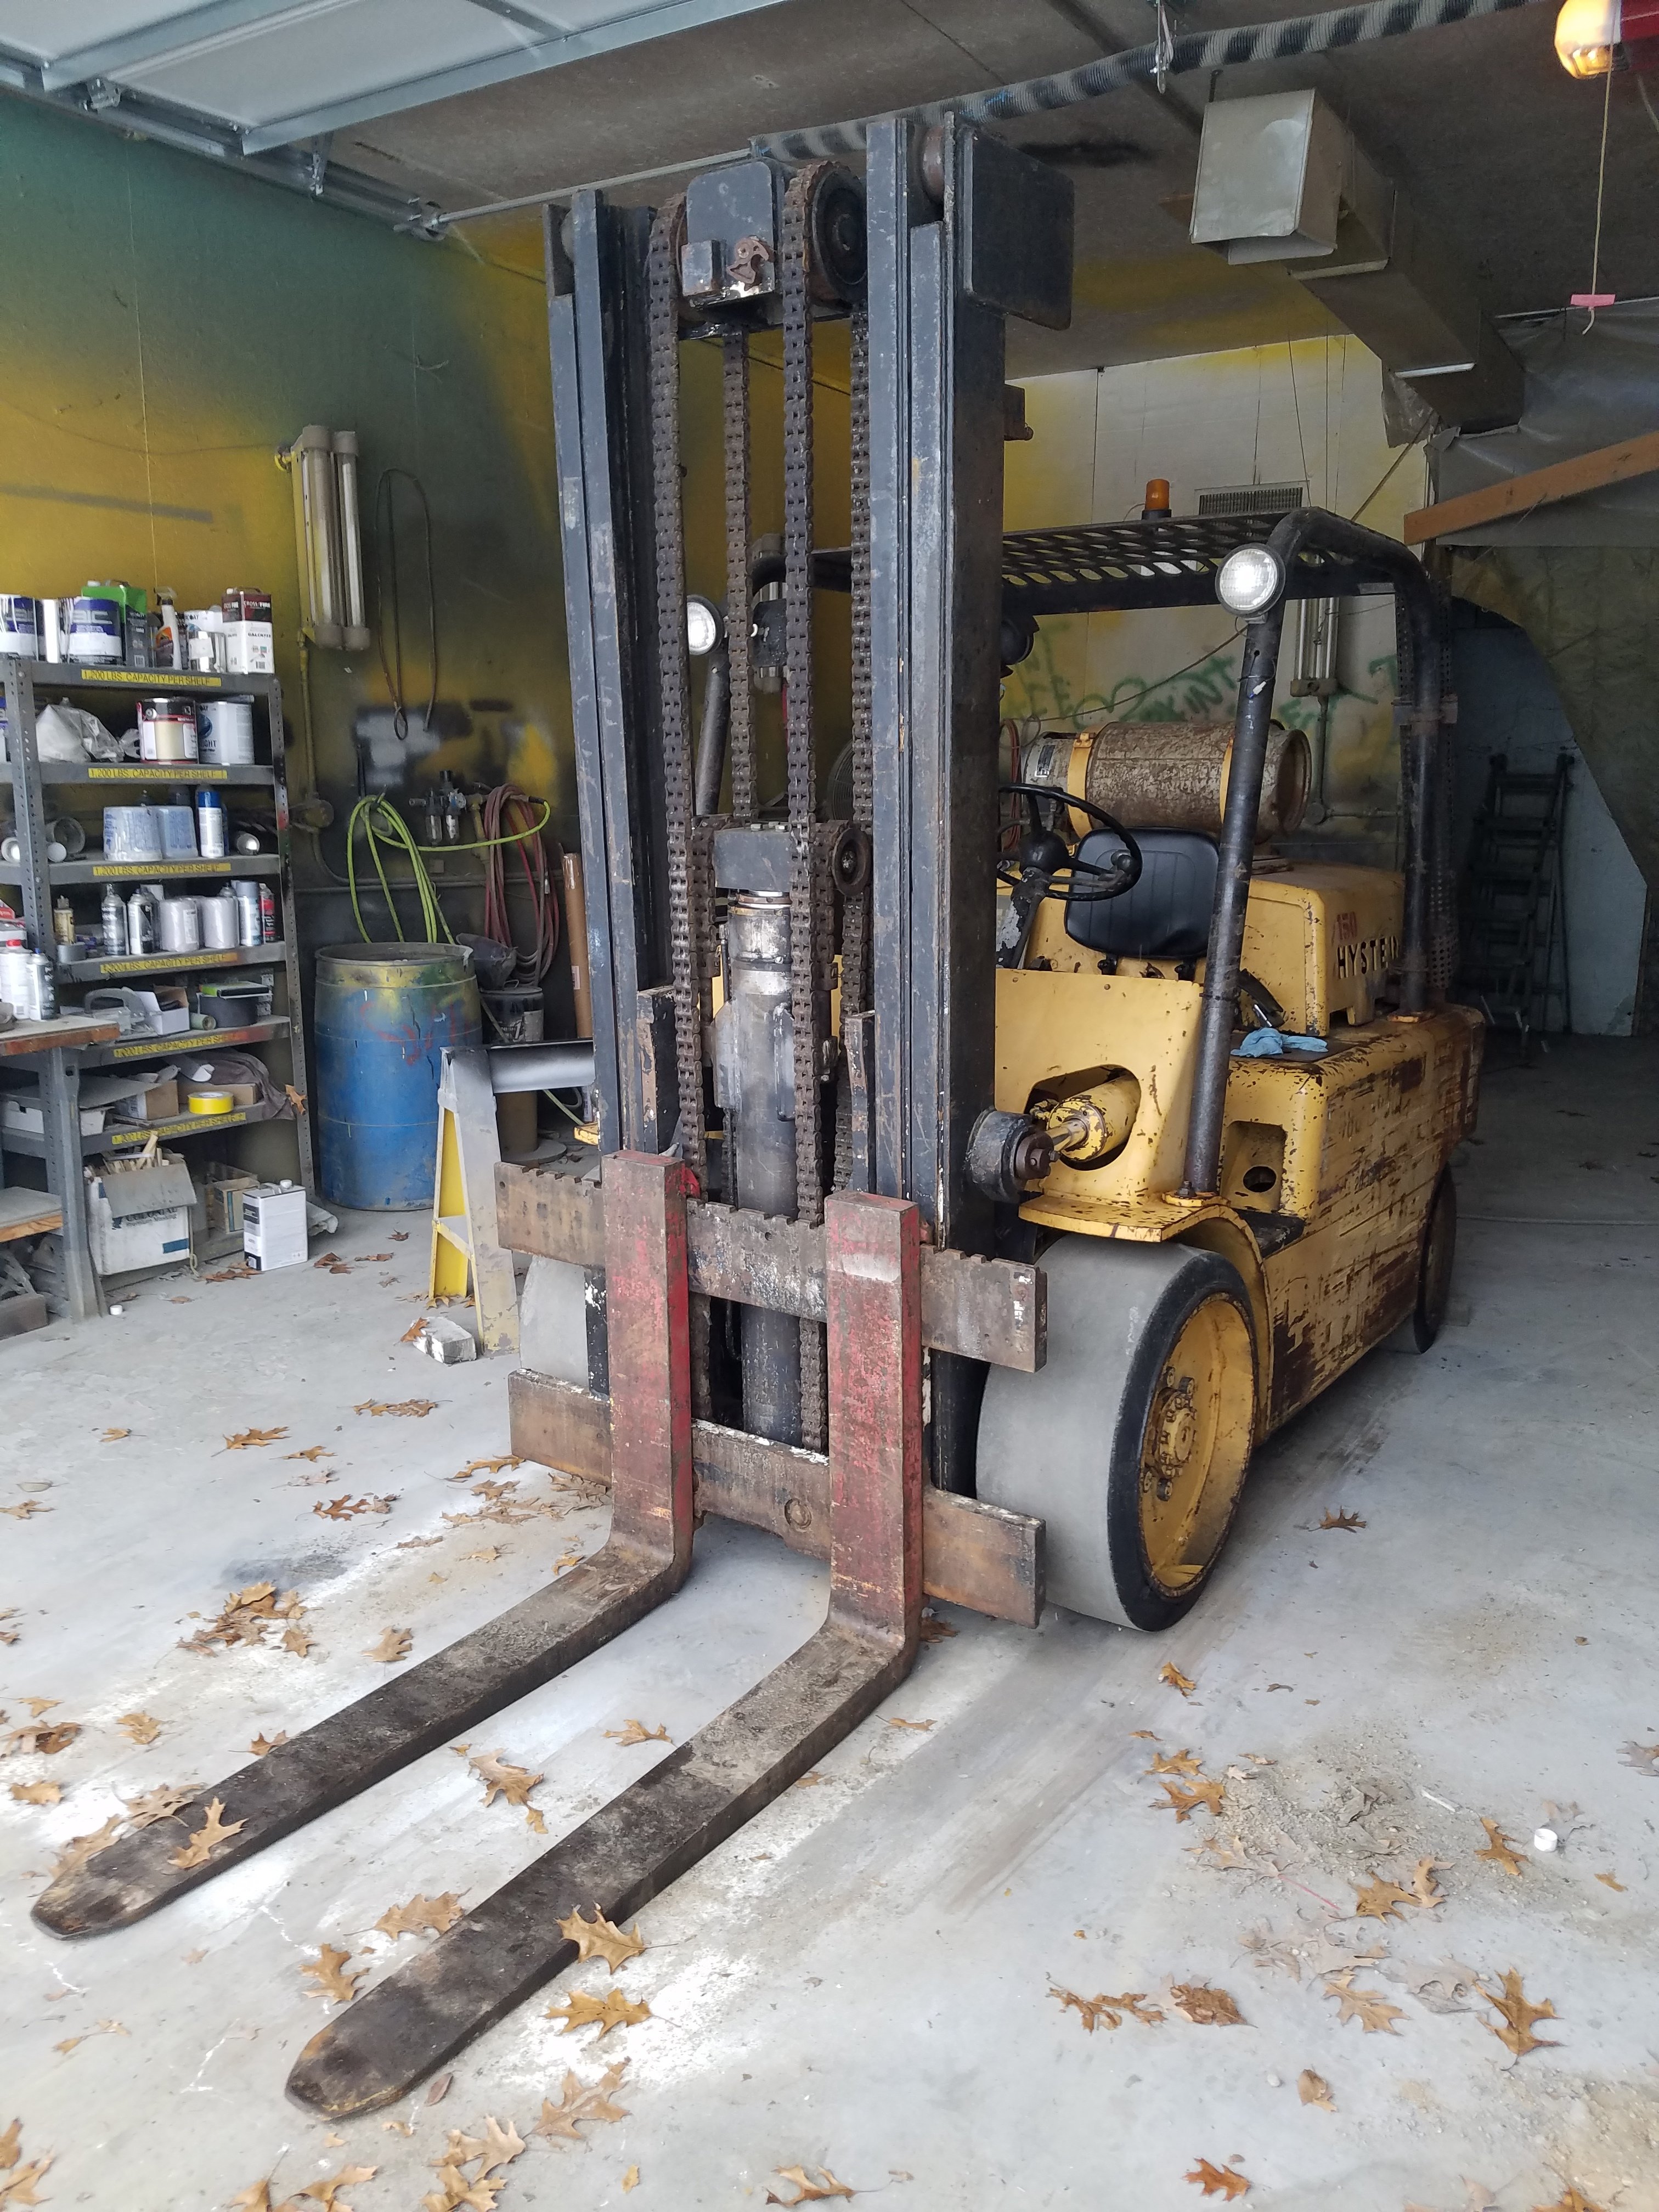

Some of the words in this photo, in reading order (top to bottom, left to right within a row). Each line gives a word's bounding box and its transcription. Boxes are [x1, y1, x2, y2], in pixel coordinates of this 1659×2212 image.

[125, 673, 166, 684] CAPACITY
[167, 674, 185, 685] PER
[185, 675, 210, 686] SHELF
[132, 769, 172, 778] CAPACITY
[174, 769, 190, 778] PER
[191, 769, 217, 778] SHELF
[137, 865, 177, 874] CAPACITY
[177, 865, 194, 873] PER
[195, 864, 220, 873] SHELF
[184, 956, 201, 966] PER
[201, 953, 227, 964] SHELF
[1337, 935, 1400, 979] HYSTER
